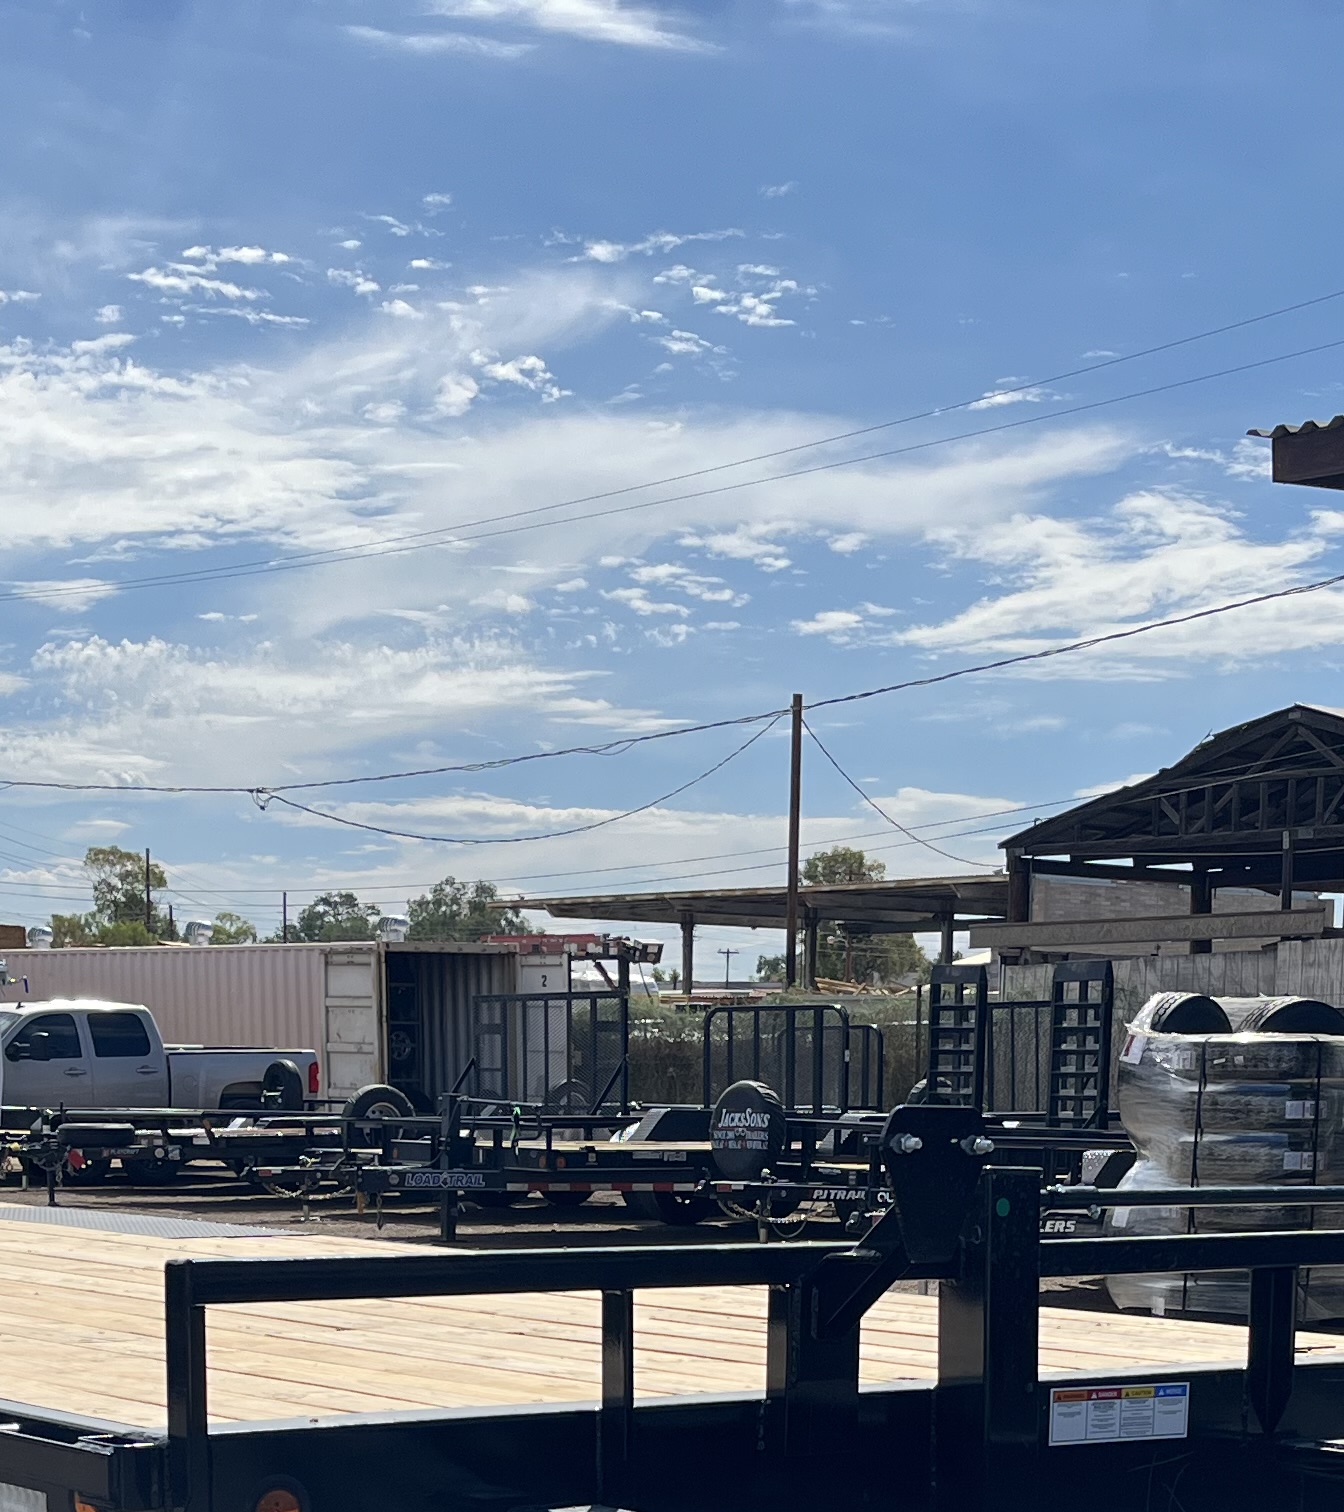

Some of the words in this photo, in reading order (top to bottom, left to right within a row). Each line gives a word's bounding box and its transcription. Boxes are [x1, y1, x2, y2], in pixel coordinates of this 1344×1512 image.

[541, 974, 548, 988] 2
[405, 1173, 440, 1187] LOAD
[448, 1173, 485, 1187] TRAIL
